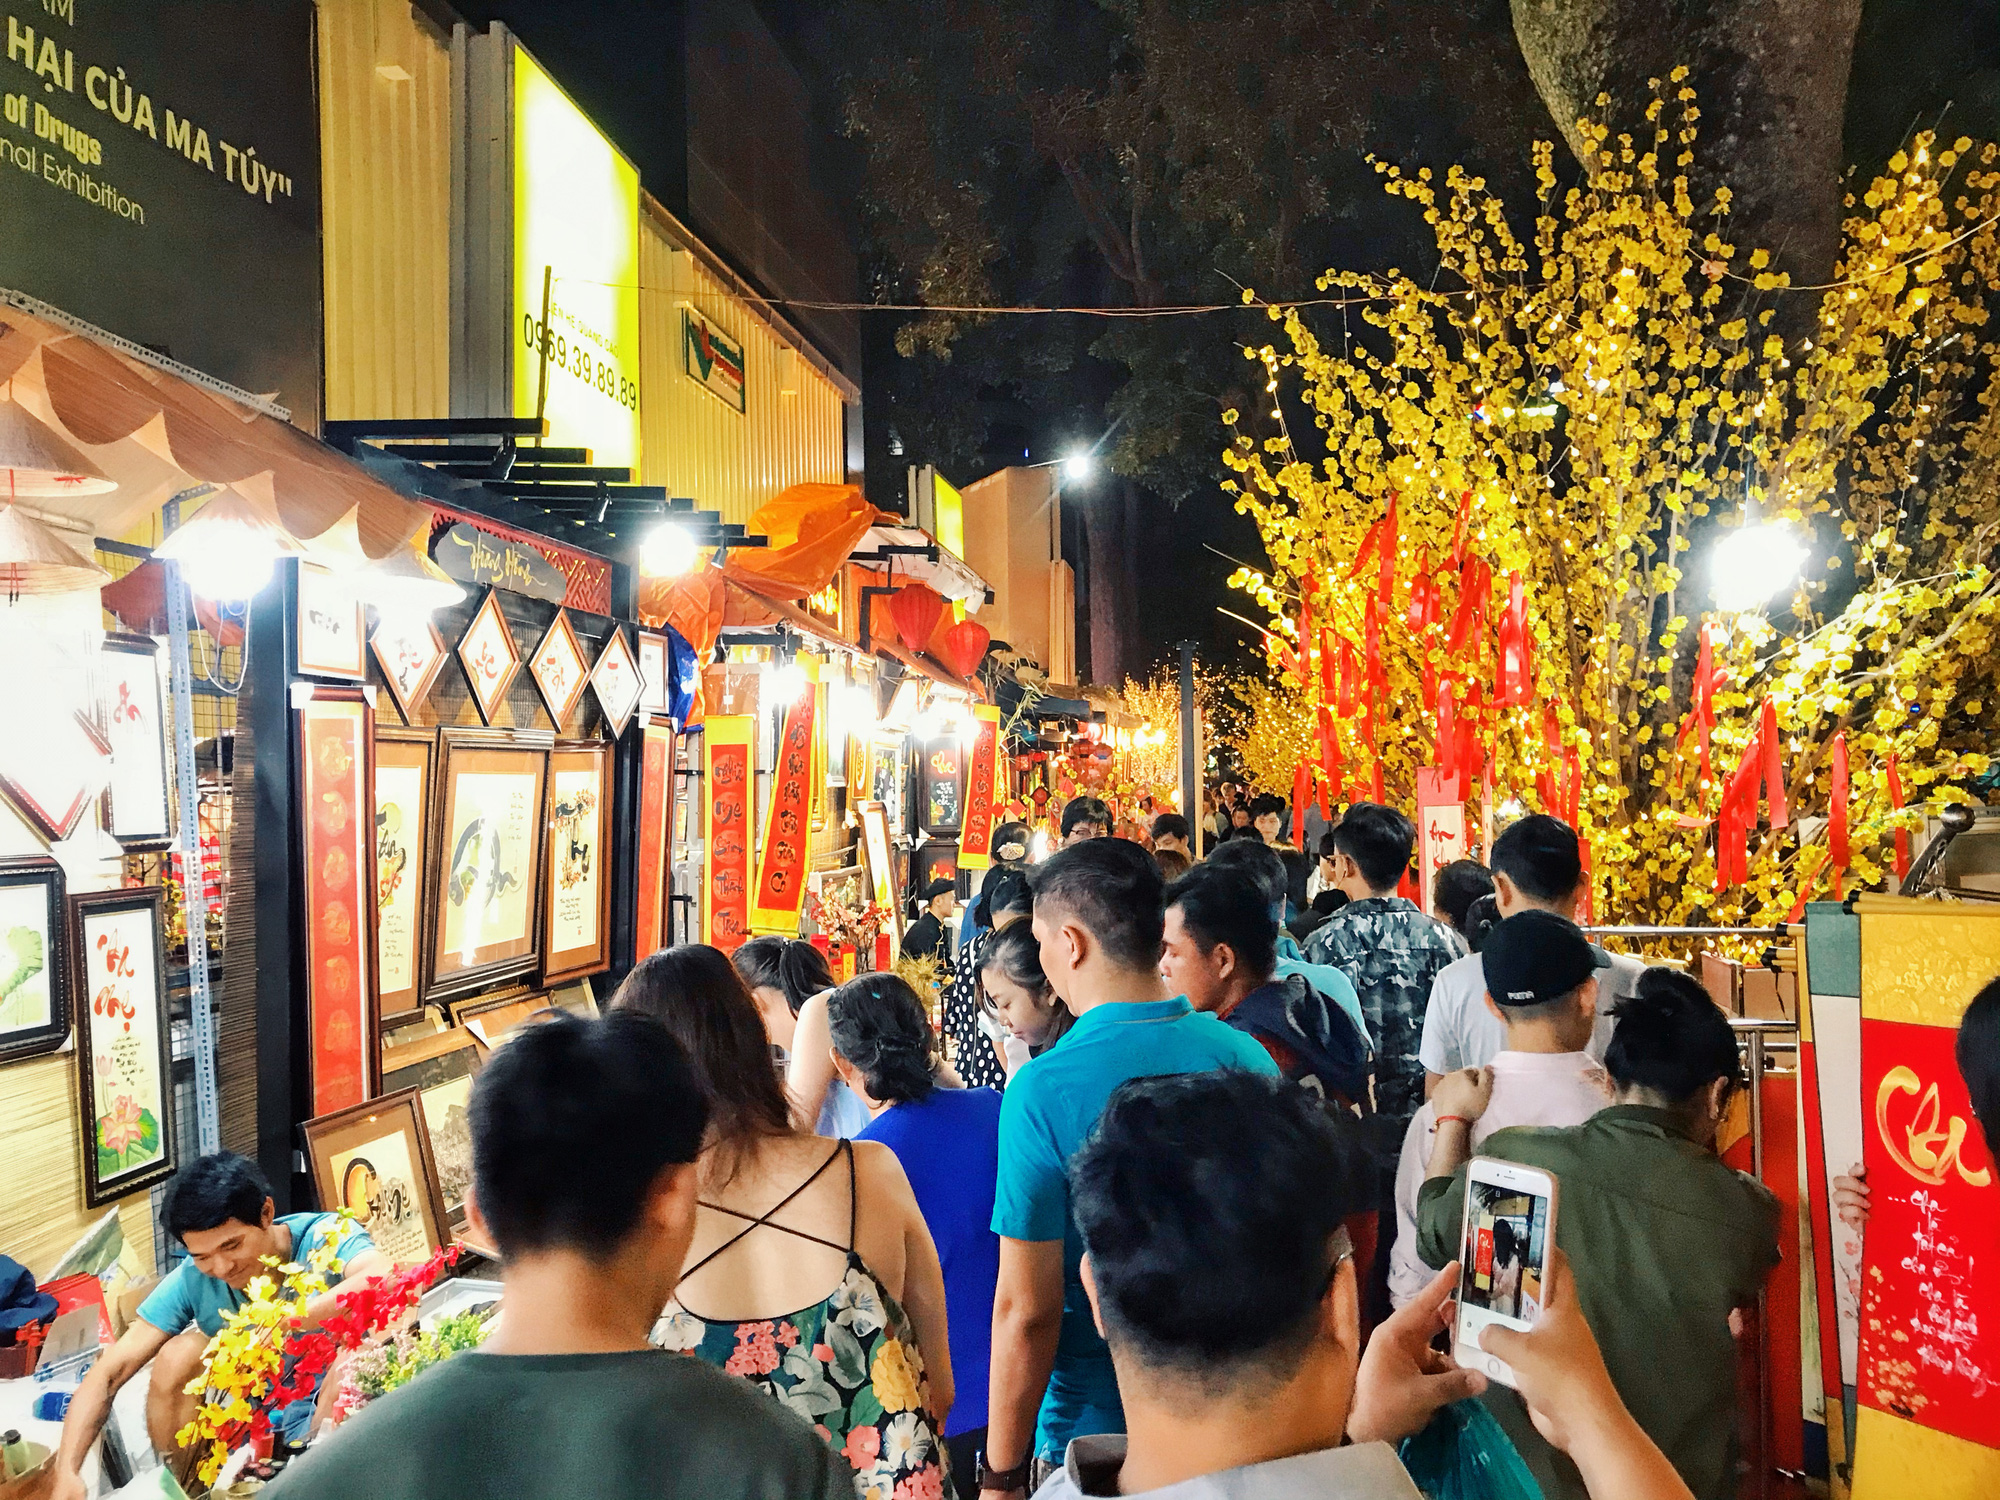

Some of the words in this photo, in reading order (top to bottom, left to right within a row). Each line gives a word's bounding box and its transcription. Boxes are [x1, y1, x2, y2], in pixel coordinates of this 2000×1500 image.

[4, 92, 29, 129] of
[34, 101, 103, 166] Drugs
[7, 15, 74, 93] HẠI
[84, 65, 157, 140] CỦA
[165, 108, 214, 173] MA
[43, 152, 146, 226] Exhibition
[524, 313, 637, 412] 0969.39.89.89
